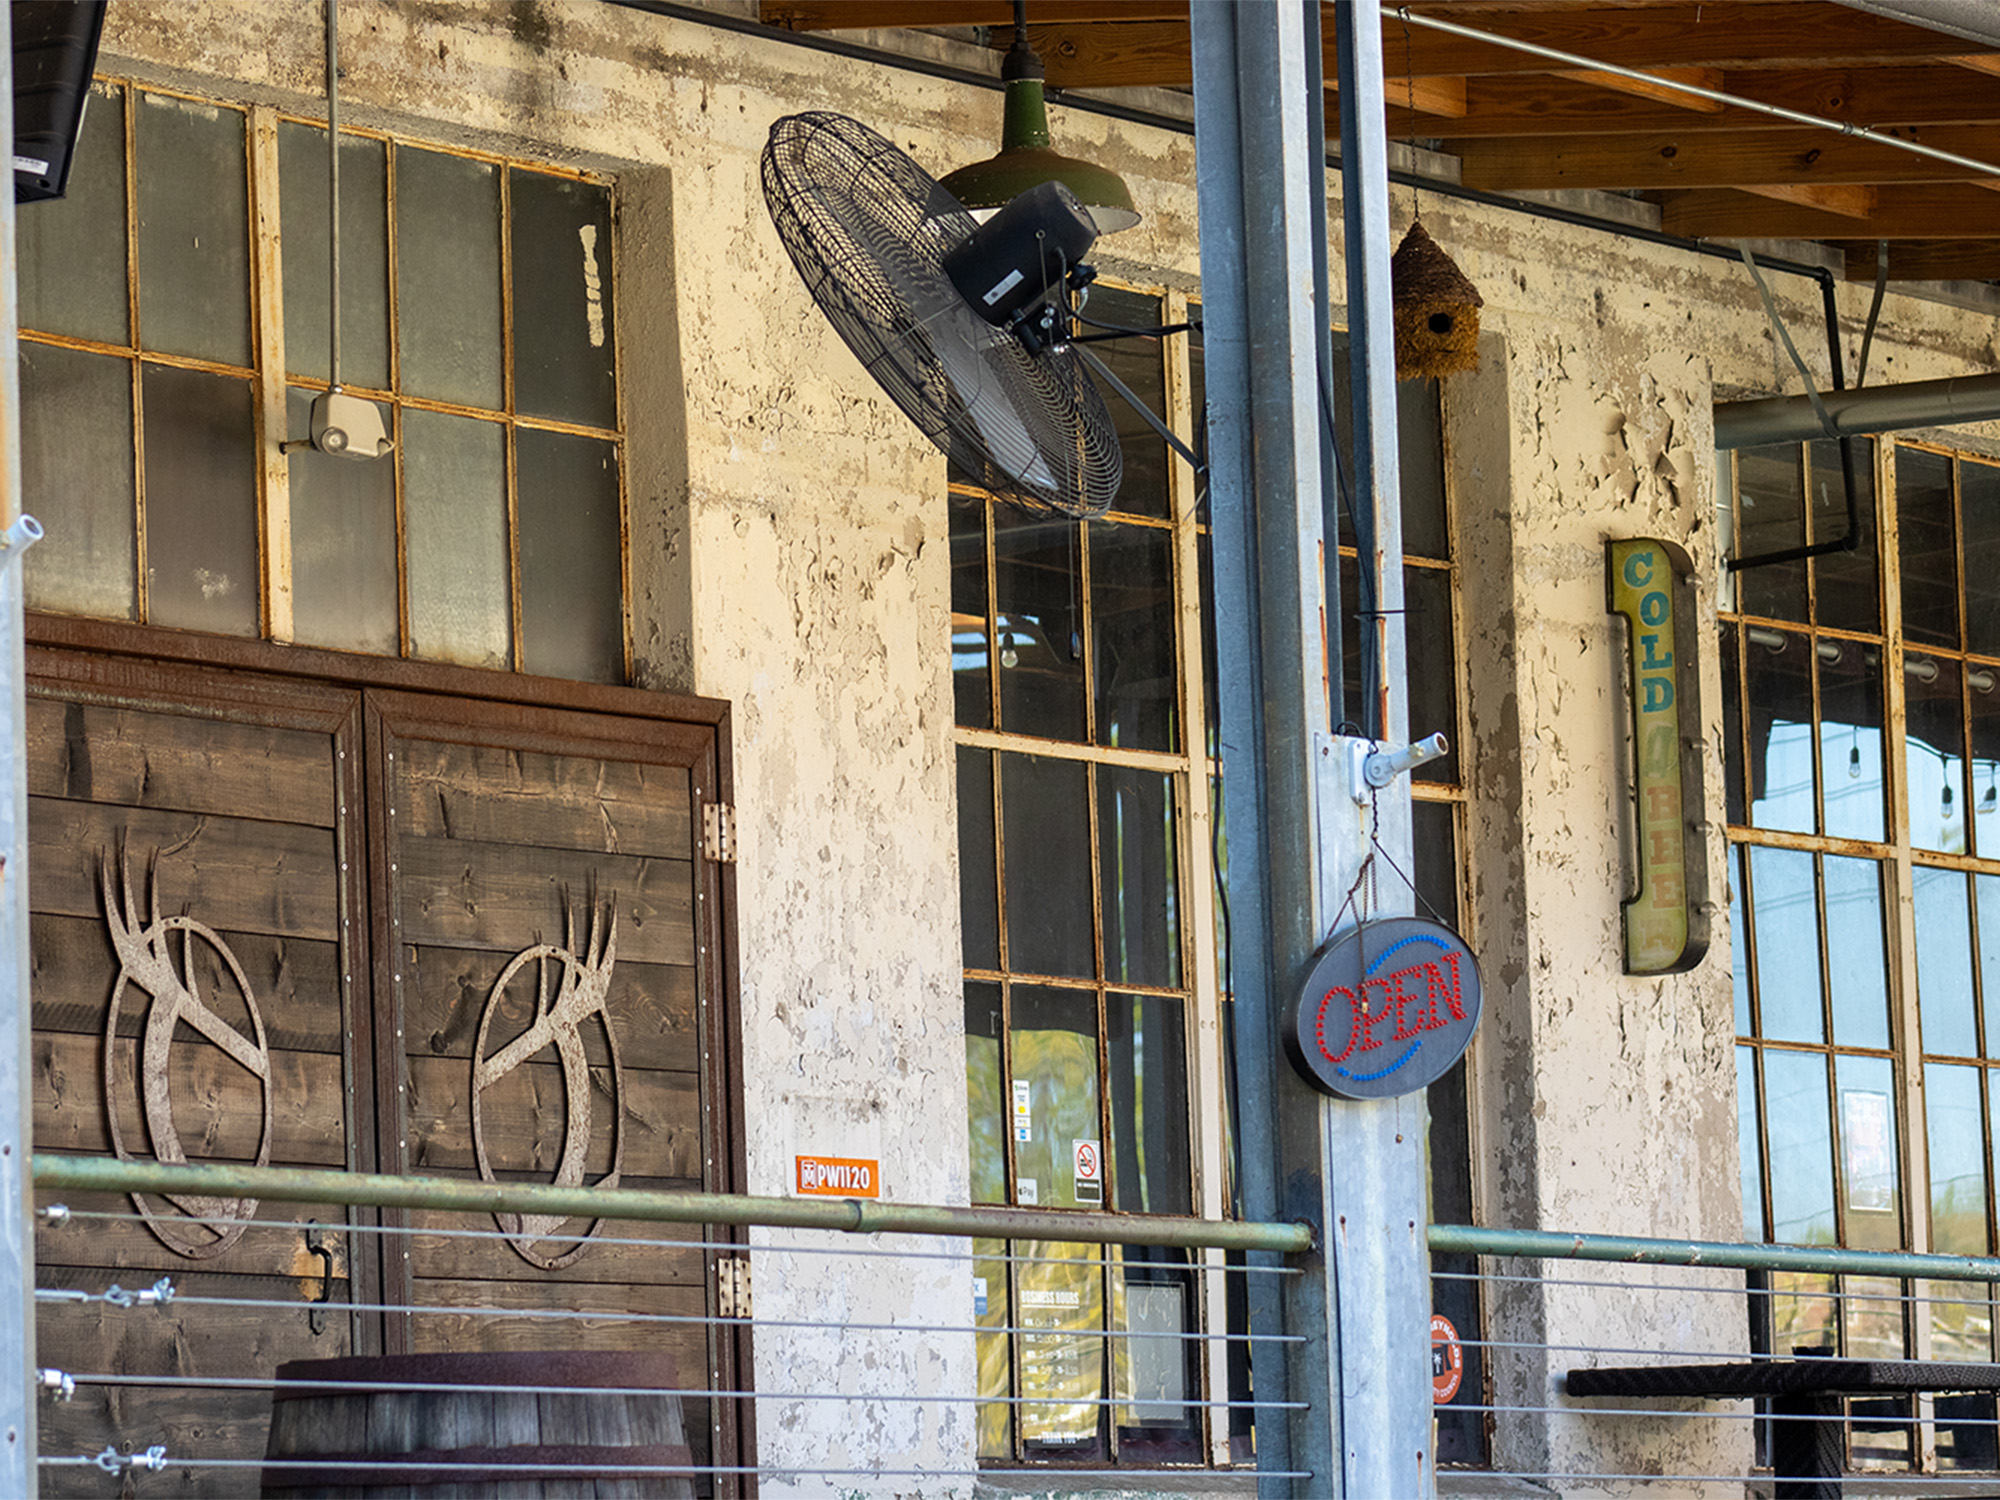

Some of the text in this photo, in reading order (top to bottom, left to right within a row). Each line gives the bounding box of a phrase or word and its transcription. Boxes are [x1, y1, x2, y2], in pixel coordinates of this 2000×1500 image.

[1623, 551, 1682, 951] COLD BEER
[1316, 951, 1468, 1063] OPEN
